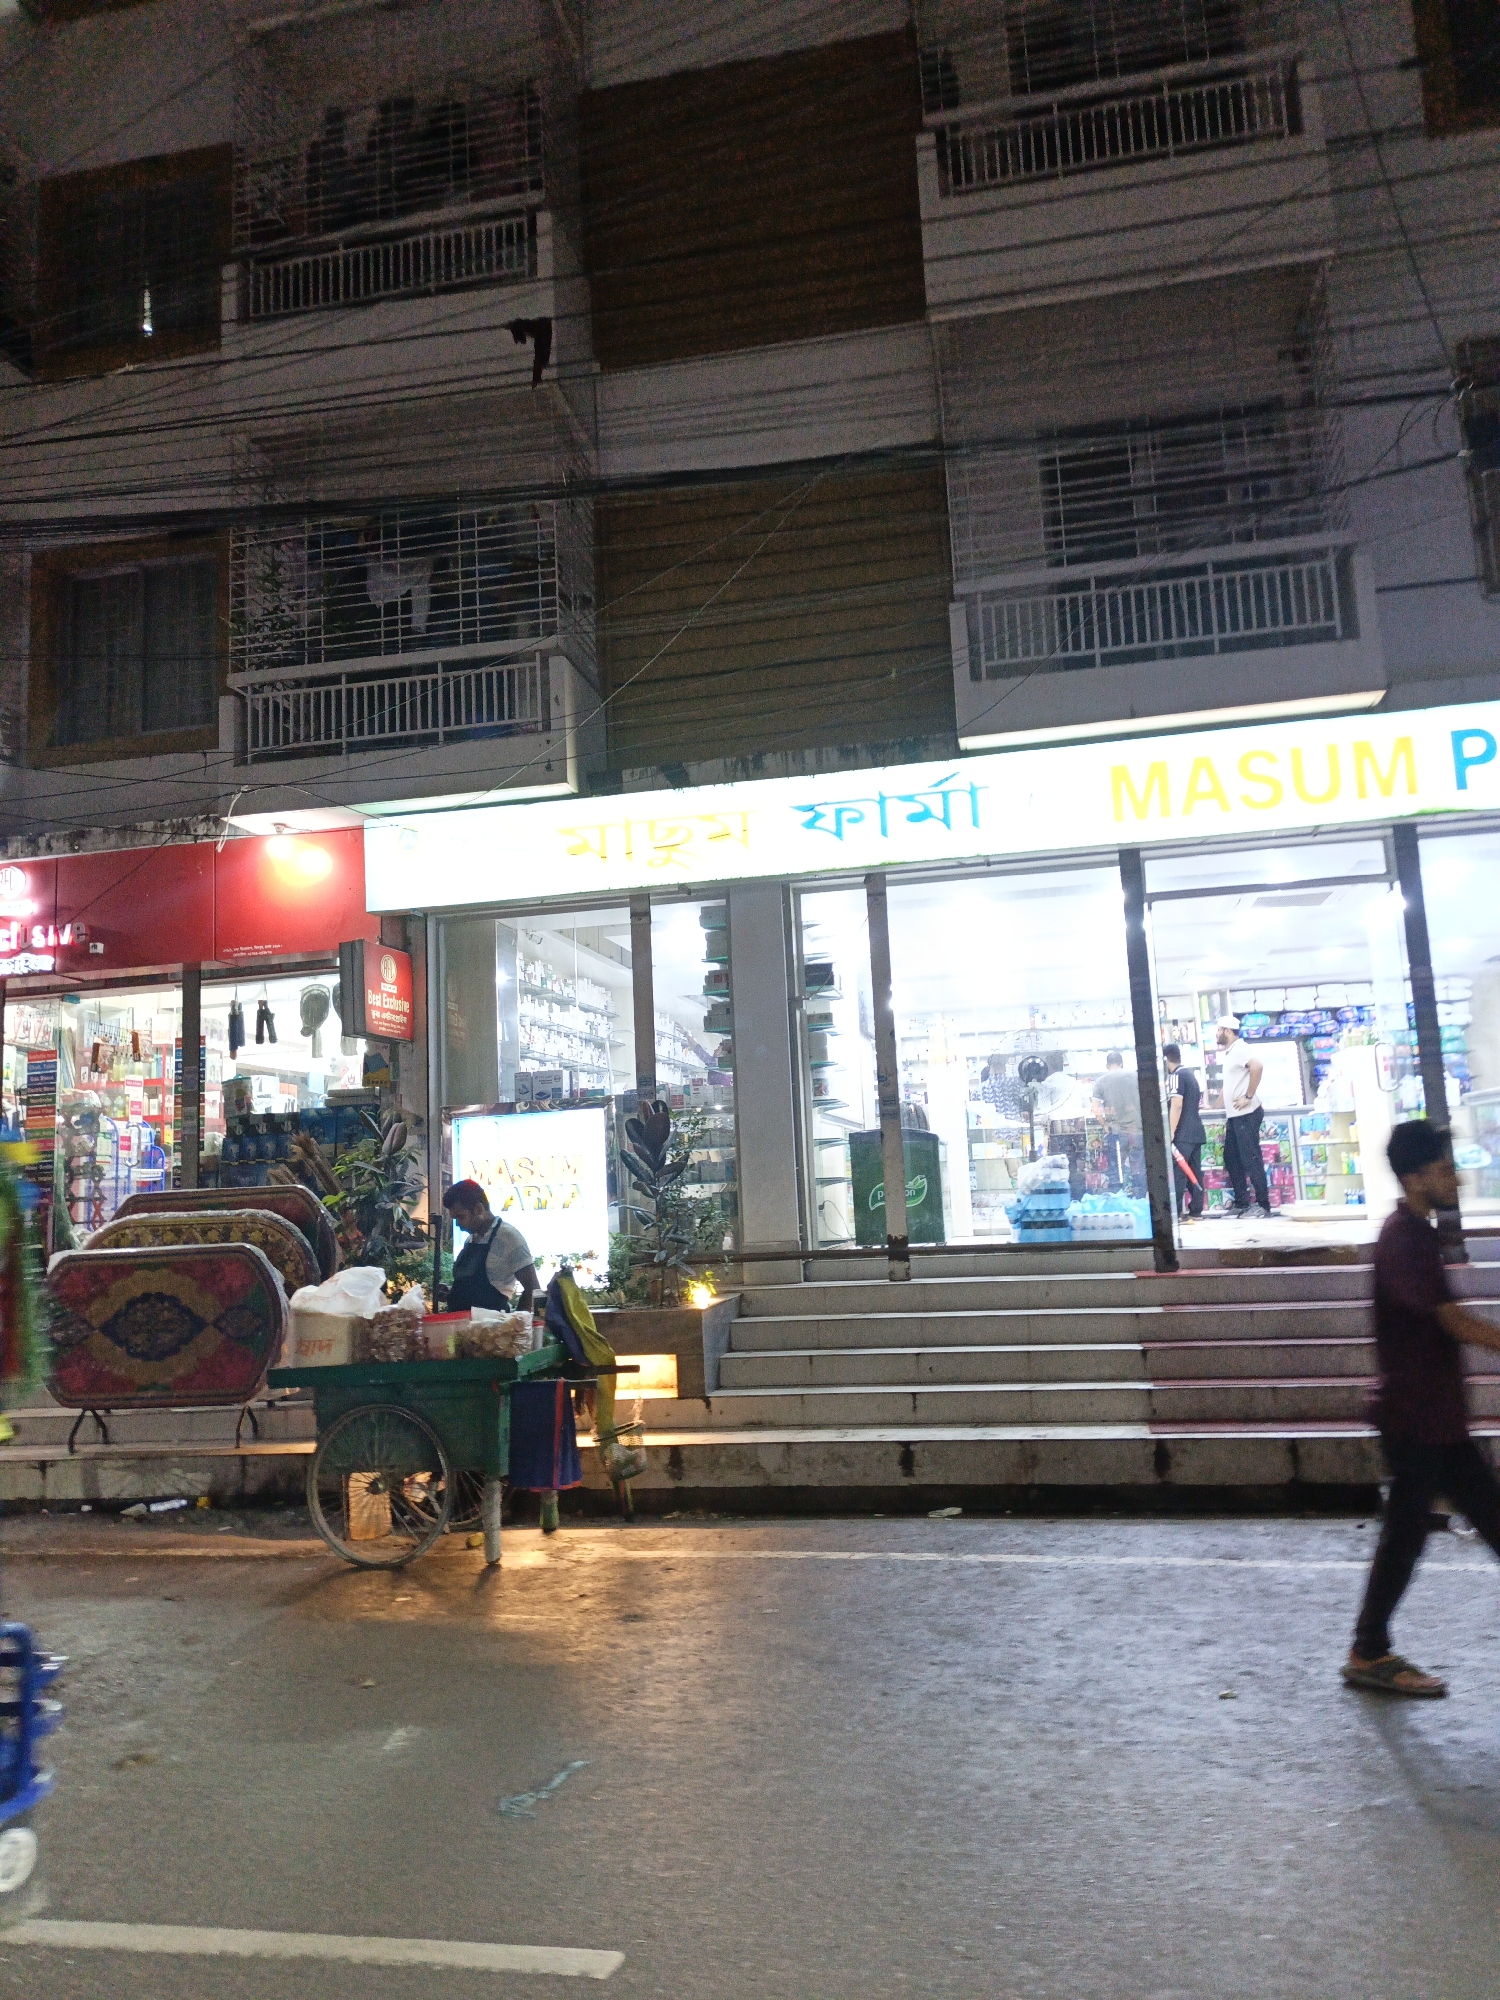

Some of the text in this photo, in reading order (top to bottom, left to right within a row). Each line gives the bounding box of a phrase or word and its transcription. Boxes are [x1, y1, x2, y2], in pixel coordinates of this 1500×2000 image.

[1110, 736, 1418, 823] MASUM
[556, 771, 990, 871] মাছুম ফার্মা
[368, 989, 410, 1013] Best Exclusive
[463, 1155, 583, 1185] MASUM
